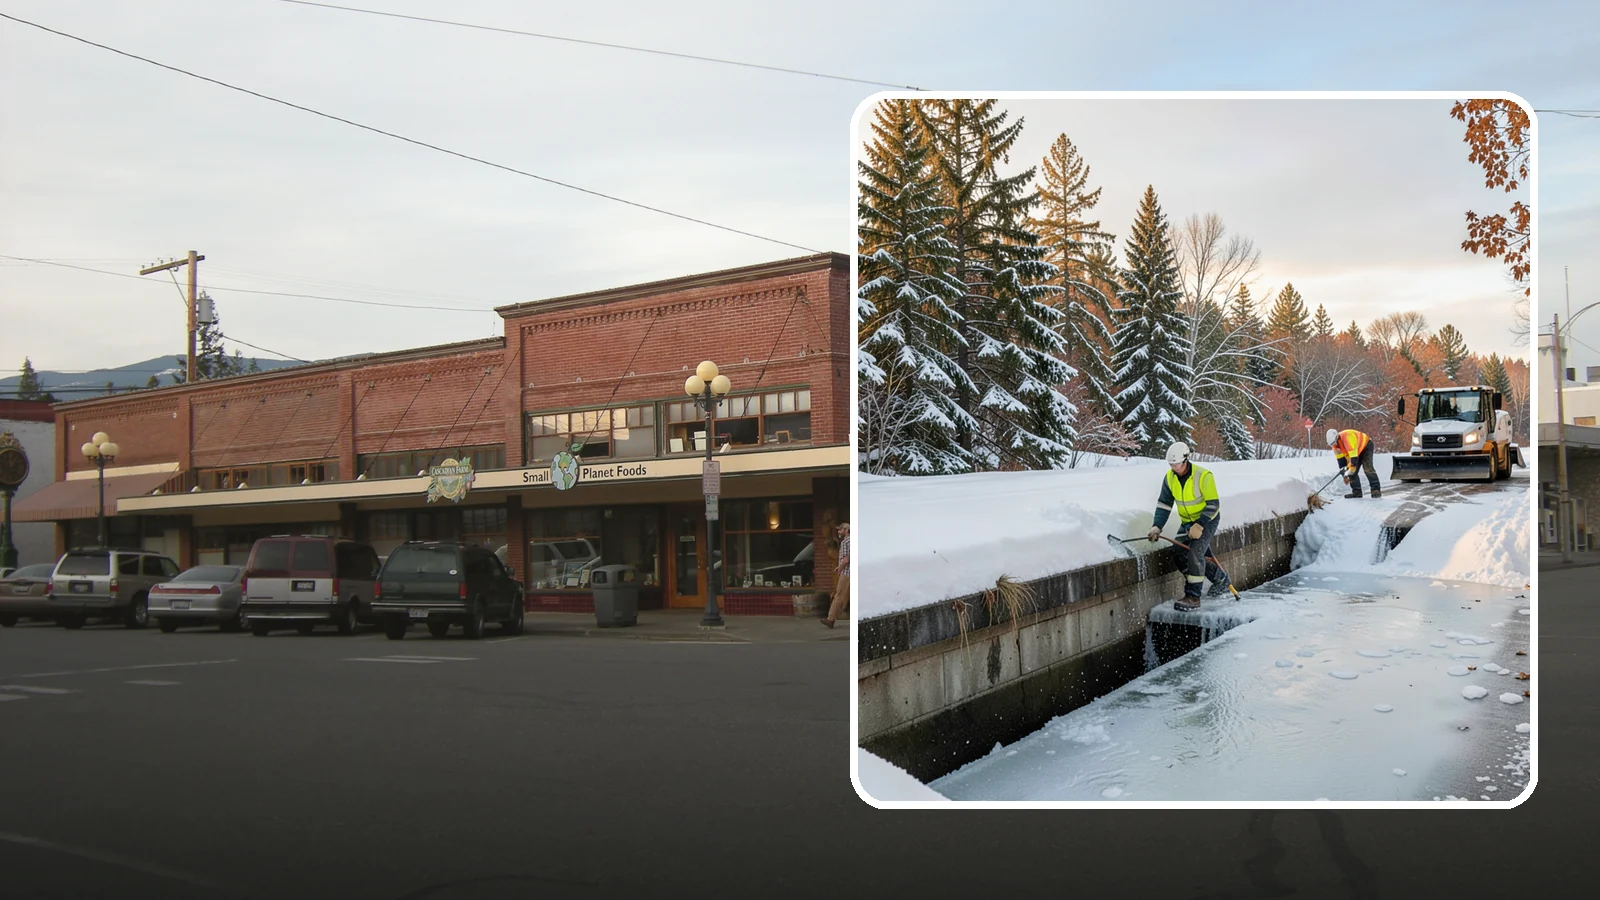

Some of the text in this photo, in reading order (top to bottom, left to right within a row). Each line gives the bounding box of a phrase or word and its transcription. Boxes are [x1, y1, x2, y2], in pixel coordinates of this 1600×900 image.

[523, 464, 647, 482] Small Planet Foods
